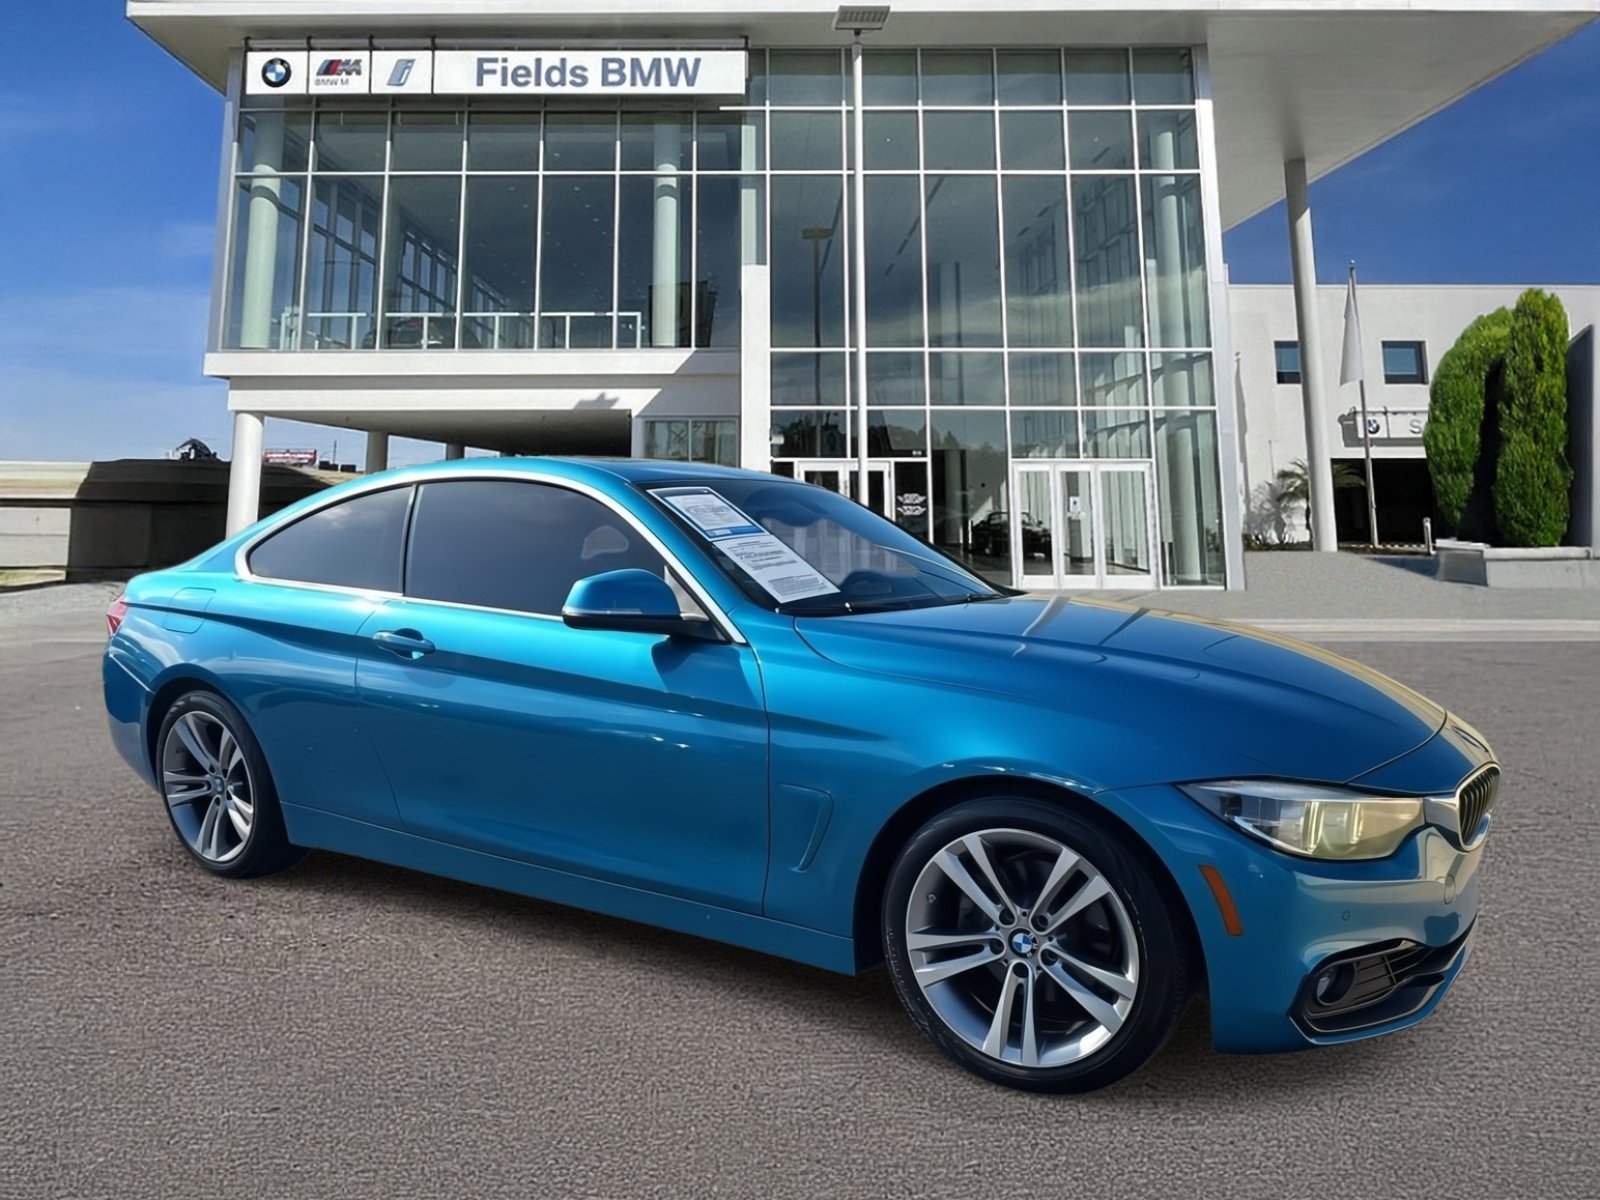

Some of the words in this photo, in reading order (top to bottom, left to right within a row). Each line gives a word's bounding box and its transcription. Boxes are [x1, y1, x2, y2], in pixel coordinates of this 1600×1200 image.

[315, 77, 338, 85] BMW
[476, 57, 589, 87] Fields
[601, 57, 701, 87] BMW
